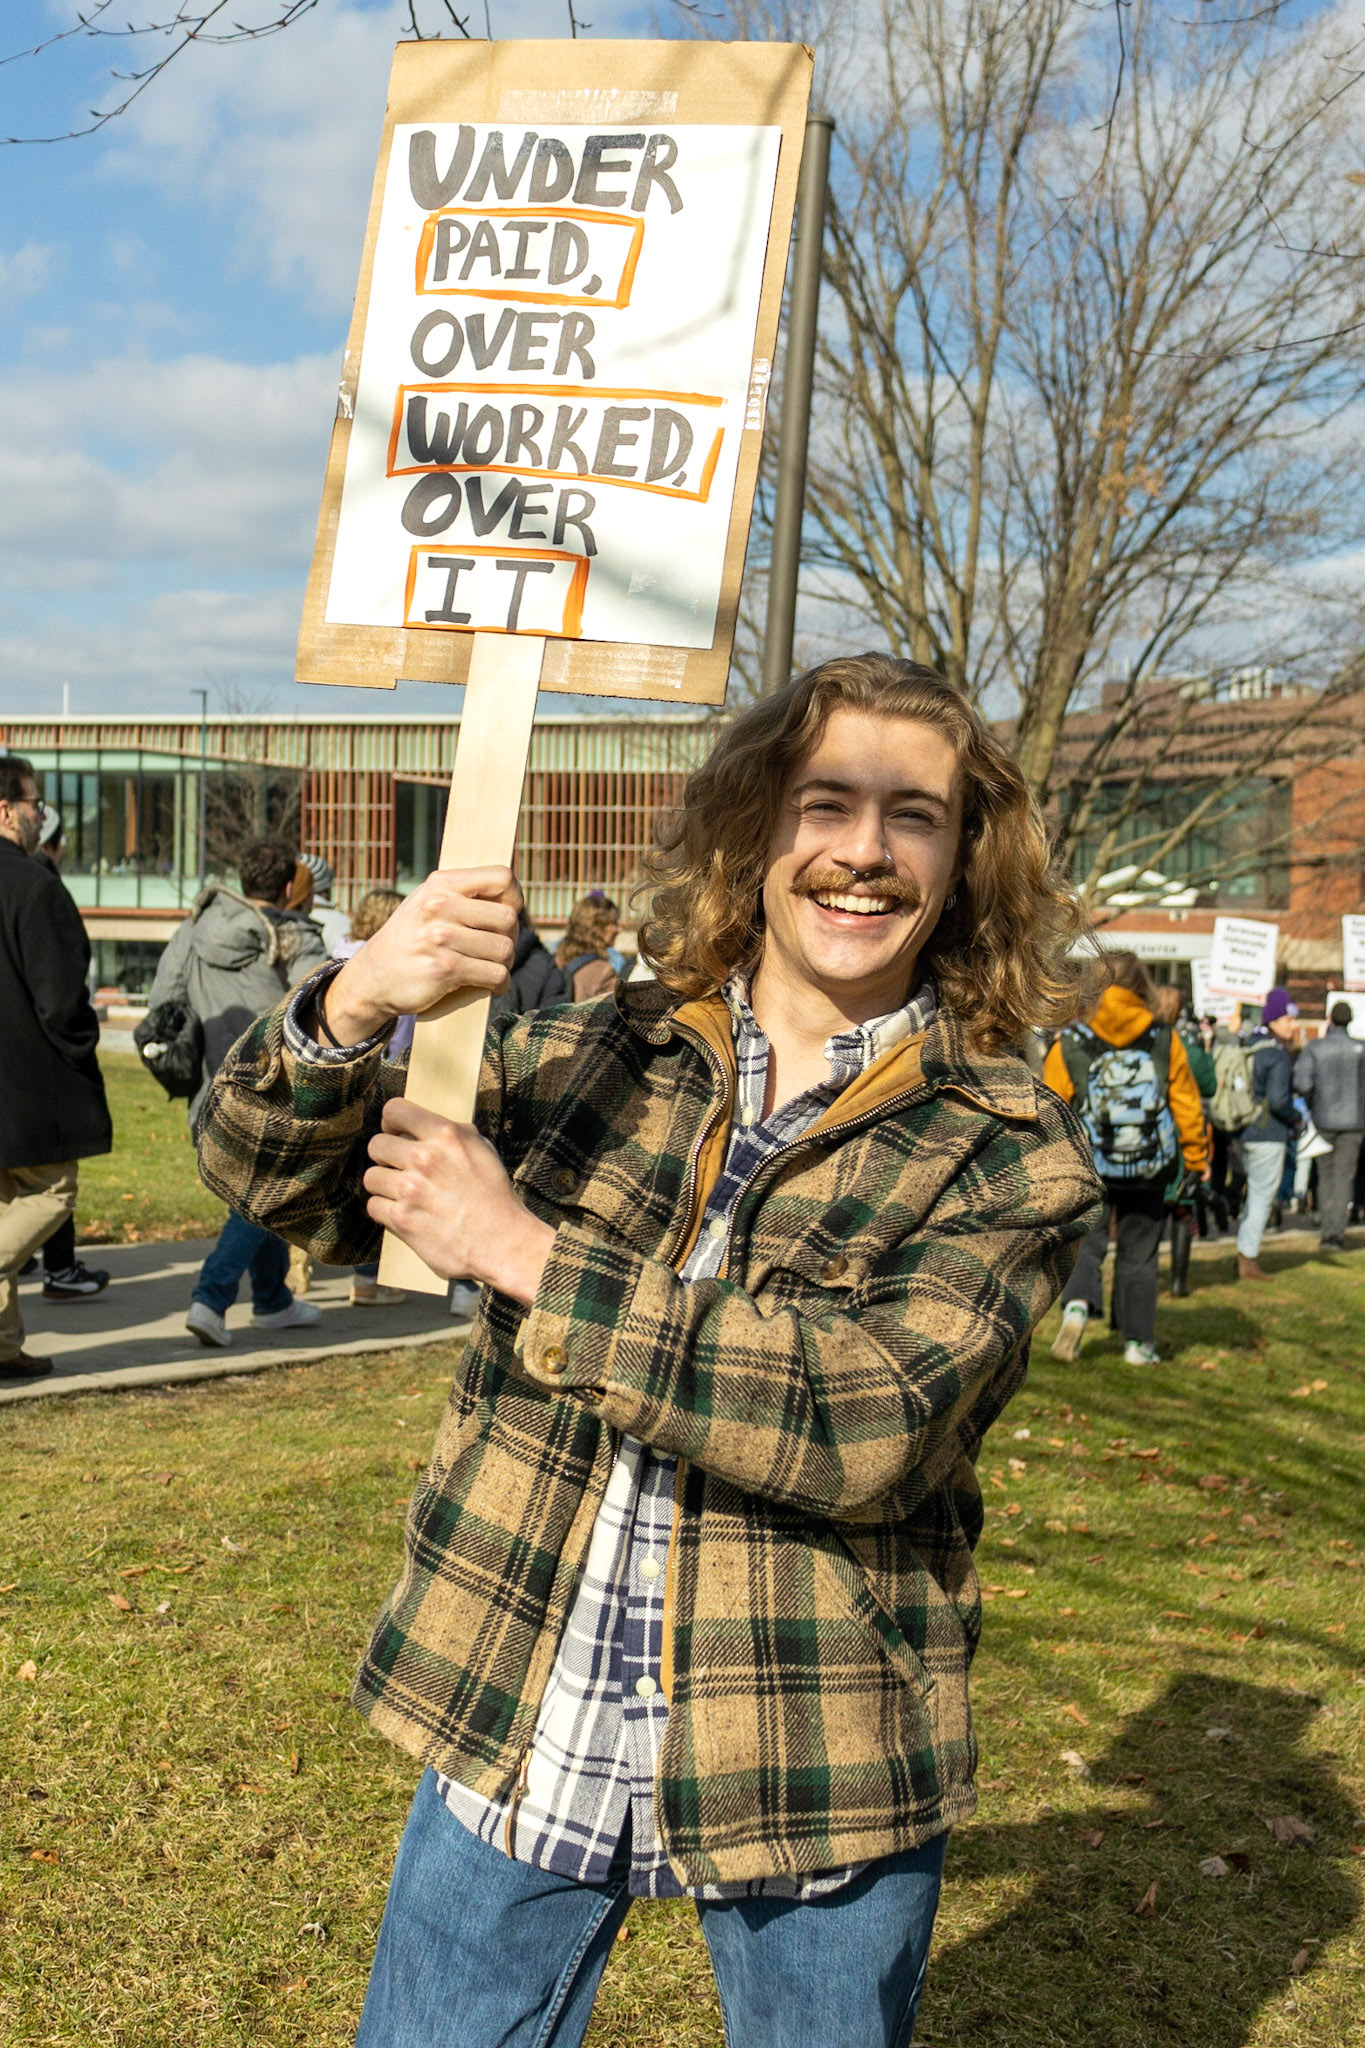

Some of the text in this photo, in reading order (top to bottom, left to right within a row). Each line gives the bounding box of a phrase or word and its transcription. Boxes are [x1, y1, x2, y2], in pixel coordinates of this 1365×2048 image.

[408, 124, 684, 215] UNDER
[433, 218, 602, 295] PAID,
[410, 307, 596, 380] OVER
[406, 395, 693, 486] WORKED,
[400, 472, 598, 557] OVER
[425, 556, 555, 632] IT
